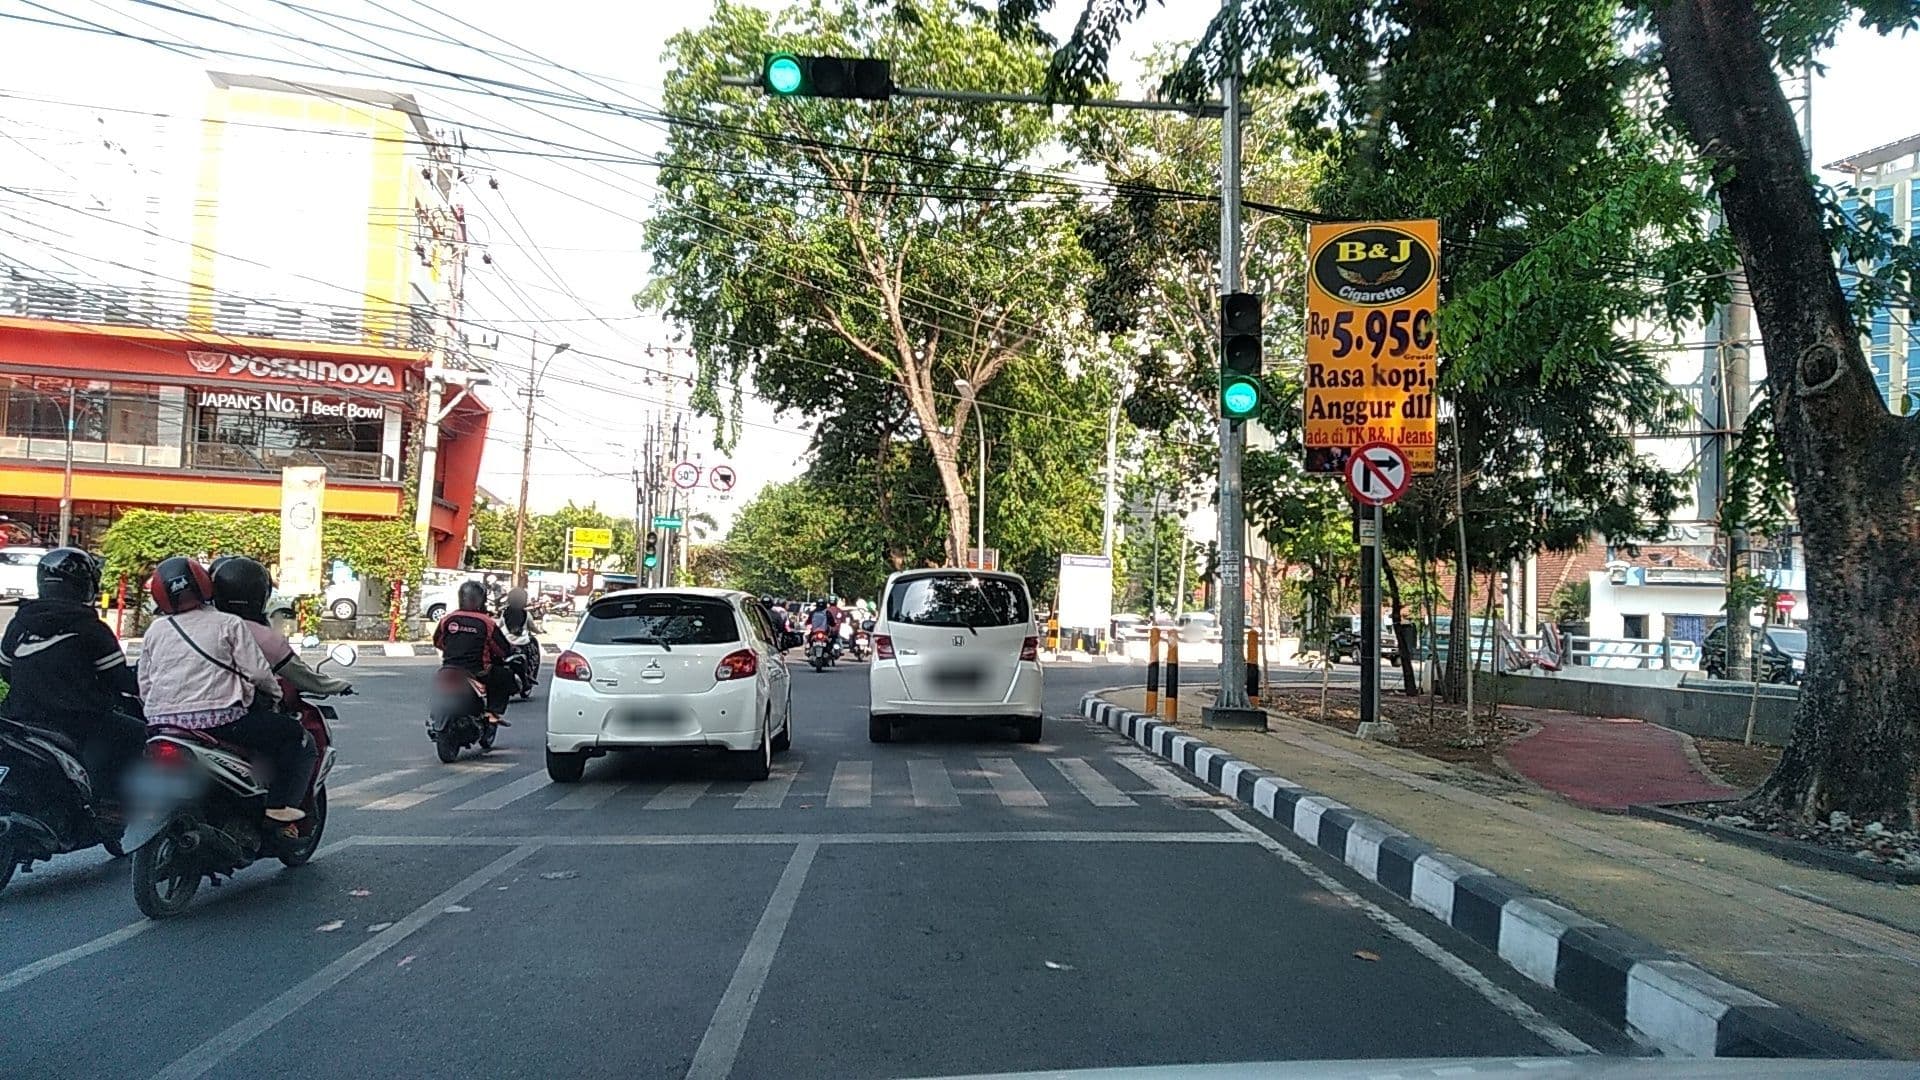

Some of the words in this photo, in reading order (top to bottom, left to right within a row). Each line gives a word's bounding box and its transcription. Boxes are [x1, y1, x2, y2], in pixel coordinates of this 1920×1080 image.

[1335, 239, 1414, 263] B&J
[1338, 285, 1407, 303] Cigarette
[1310, 311, 1330, 340] Rp
[228, 354, 396, 386] YOSHINOYA
[1308, 363, 1365, 389] Rasa
[1371, 362, 1434, 393] kopi,
[198, 392, 262, 411] JAPAN'S
[311, 400, 346, 417] Beef
[346, 403, 384, 420] Bowl
[1308, 394, 1396, 425] Anggur
[1306, 428, 1328, 445] ada
[1331, 427, 1343, 444] di
[1346, 426, 1365, 444] TK
[1397, 427, 1434, 444] Jeans
[677, 470, 689, 480] 50
